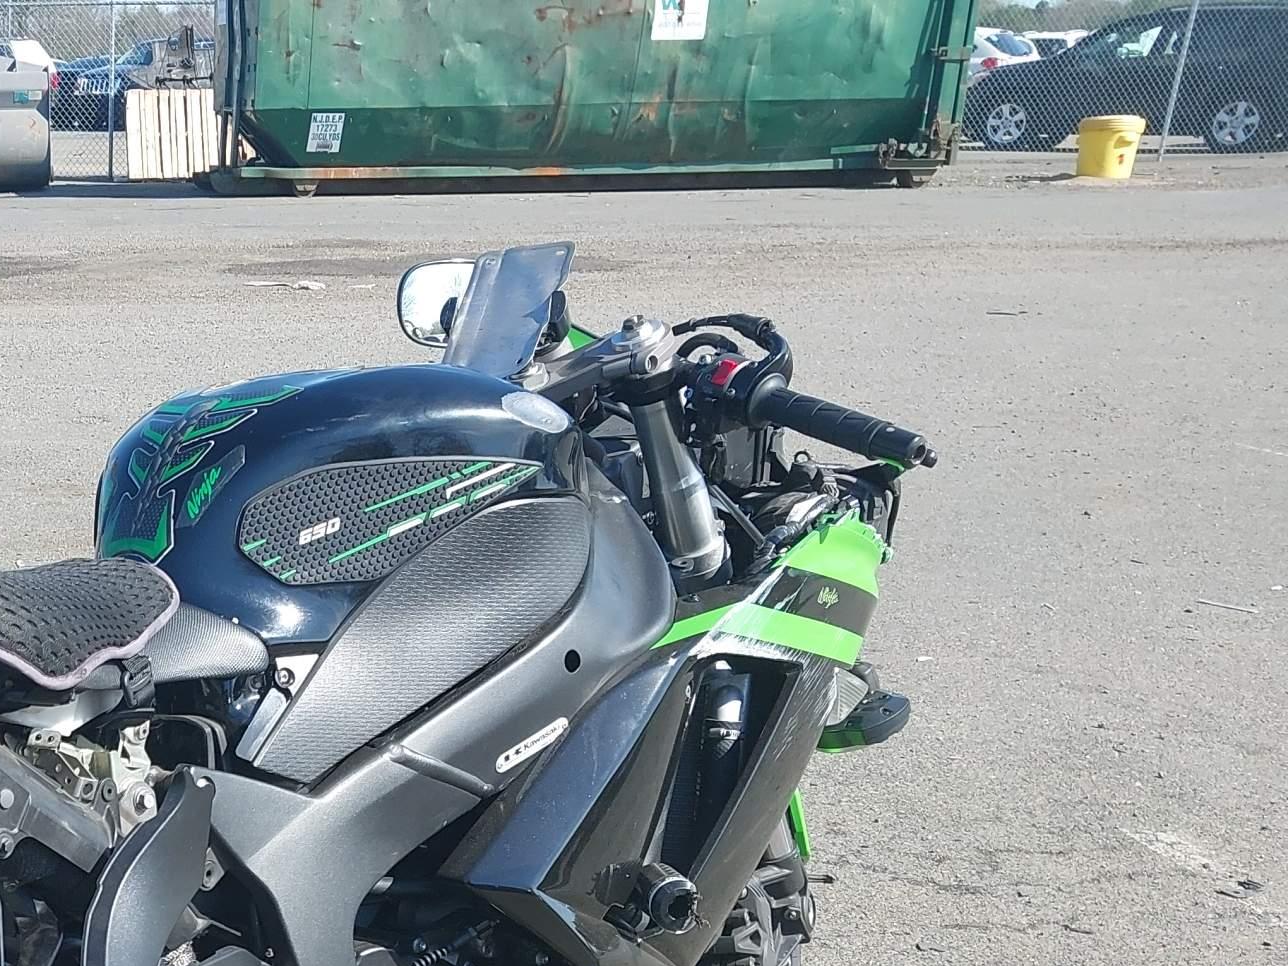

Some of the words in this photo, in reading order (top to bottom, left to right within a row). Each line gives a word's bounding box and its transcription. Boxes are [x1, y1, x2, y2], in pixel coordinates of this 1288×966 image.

[316, 124, 338, 132] 17273
[187, 466, 222, 519] Ninja
[299, 517, 341, 546] 650
[523, 725, 561, 751] Kawasaki
